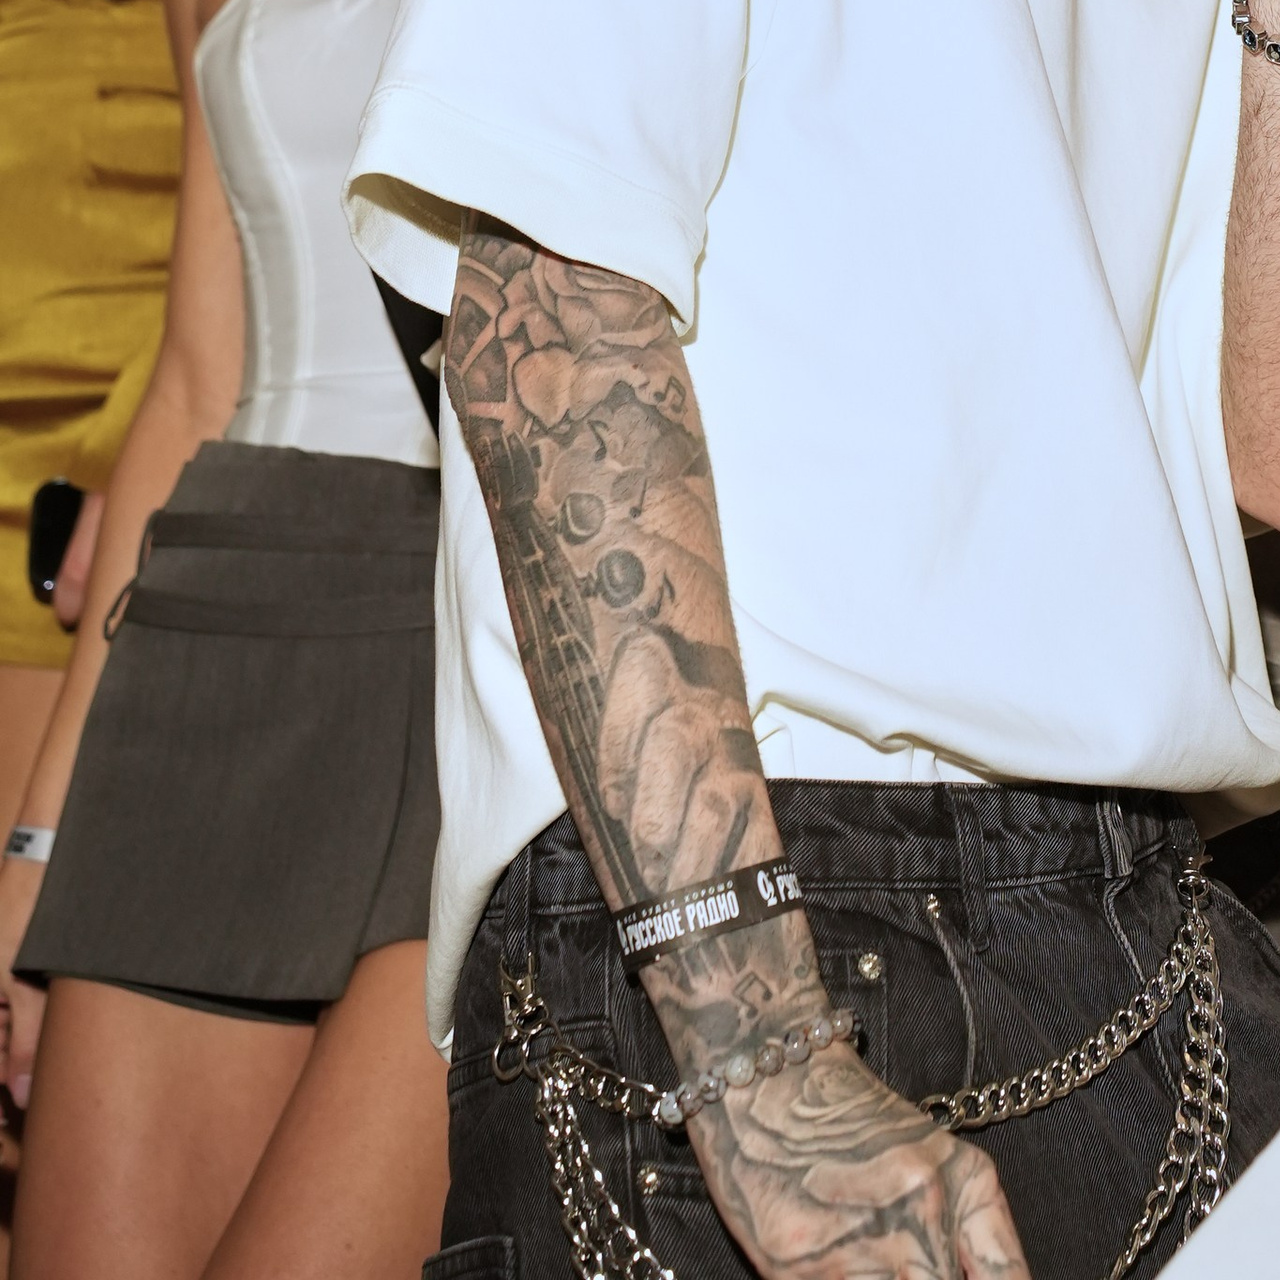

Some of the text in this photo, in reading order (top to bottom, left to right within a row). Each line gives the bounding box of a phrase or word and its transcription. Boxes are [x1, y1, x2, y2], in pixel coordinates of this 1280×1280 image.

[626, 890, 739, 953] РУССКОЕ РАДИО
[641, 899, 675, 918] БУДЕТ
[684, 880, 734, 903] ХОРОШО
